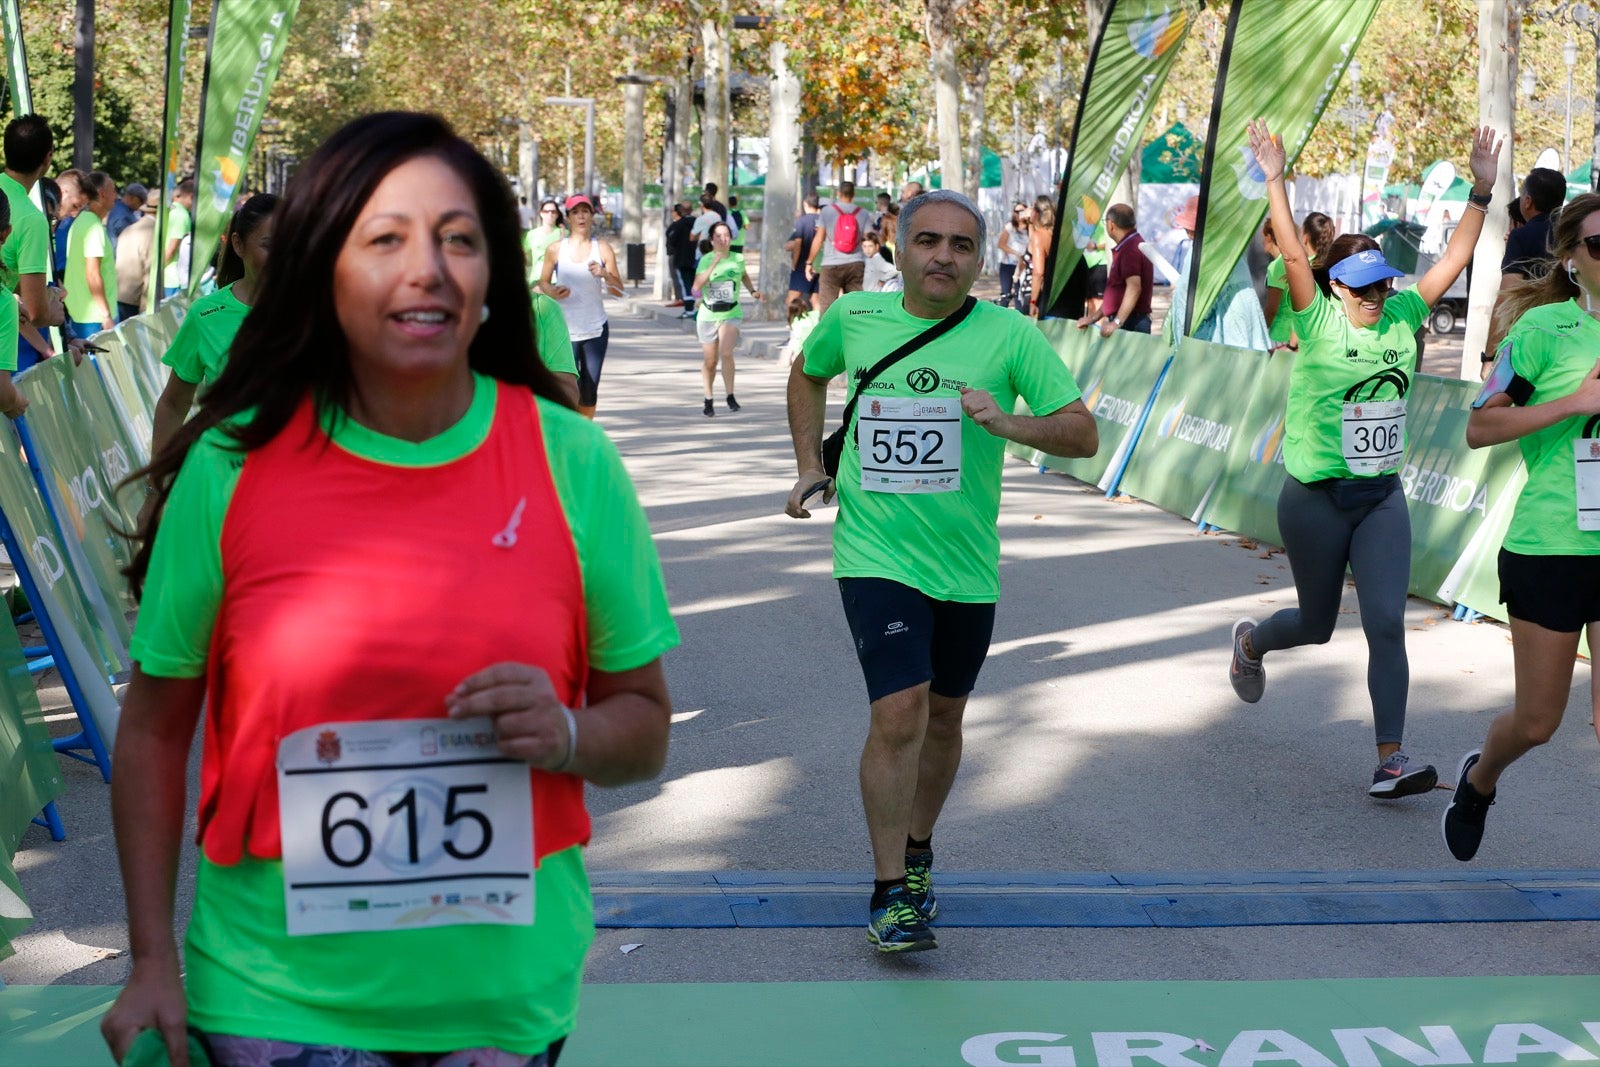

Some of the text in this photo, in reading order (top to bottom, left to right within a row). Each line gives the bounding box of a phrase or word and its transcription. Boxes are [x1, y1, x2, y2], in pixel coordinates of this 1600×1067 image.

[1093, 73, 1157, 200] IBERDROLA
[941, 383, 967, 392] MUJE
[872, 430, 943, 465] 552
[1173, 412, 1233, 453] IBERDROLA
[1353, 423, 1399, 453] 306
[321, 784, 493, 867] 615
[960, 1022, 1600, 1067] GRANA
